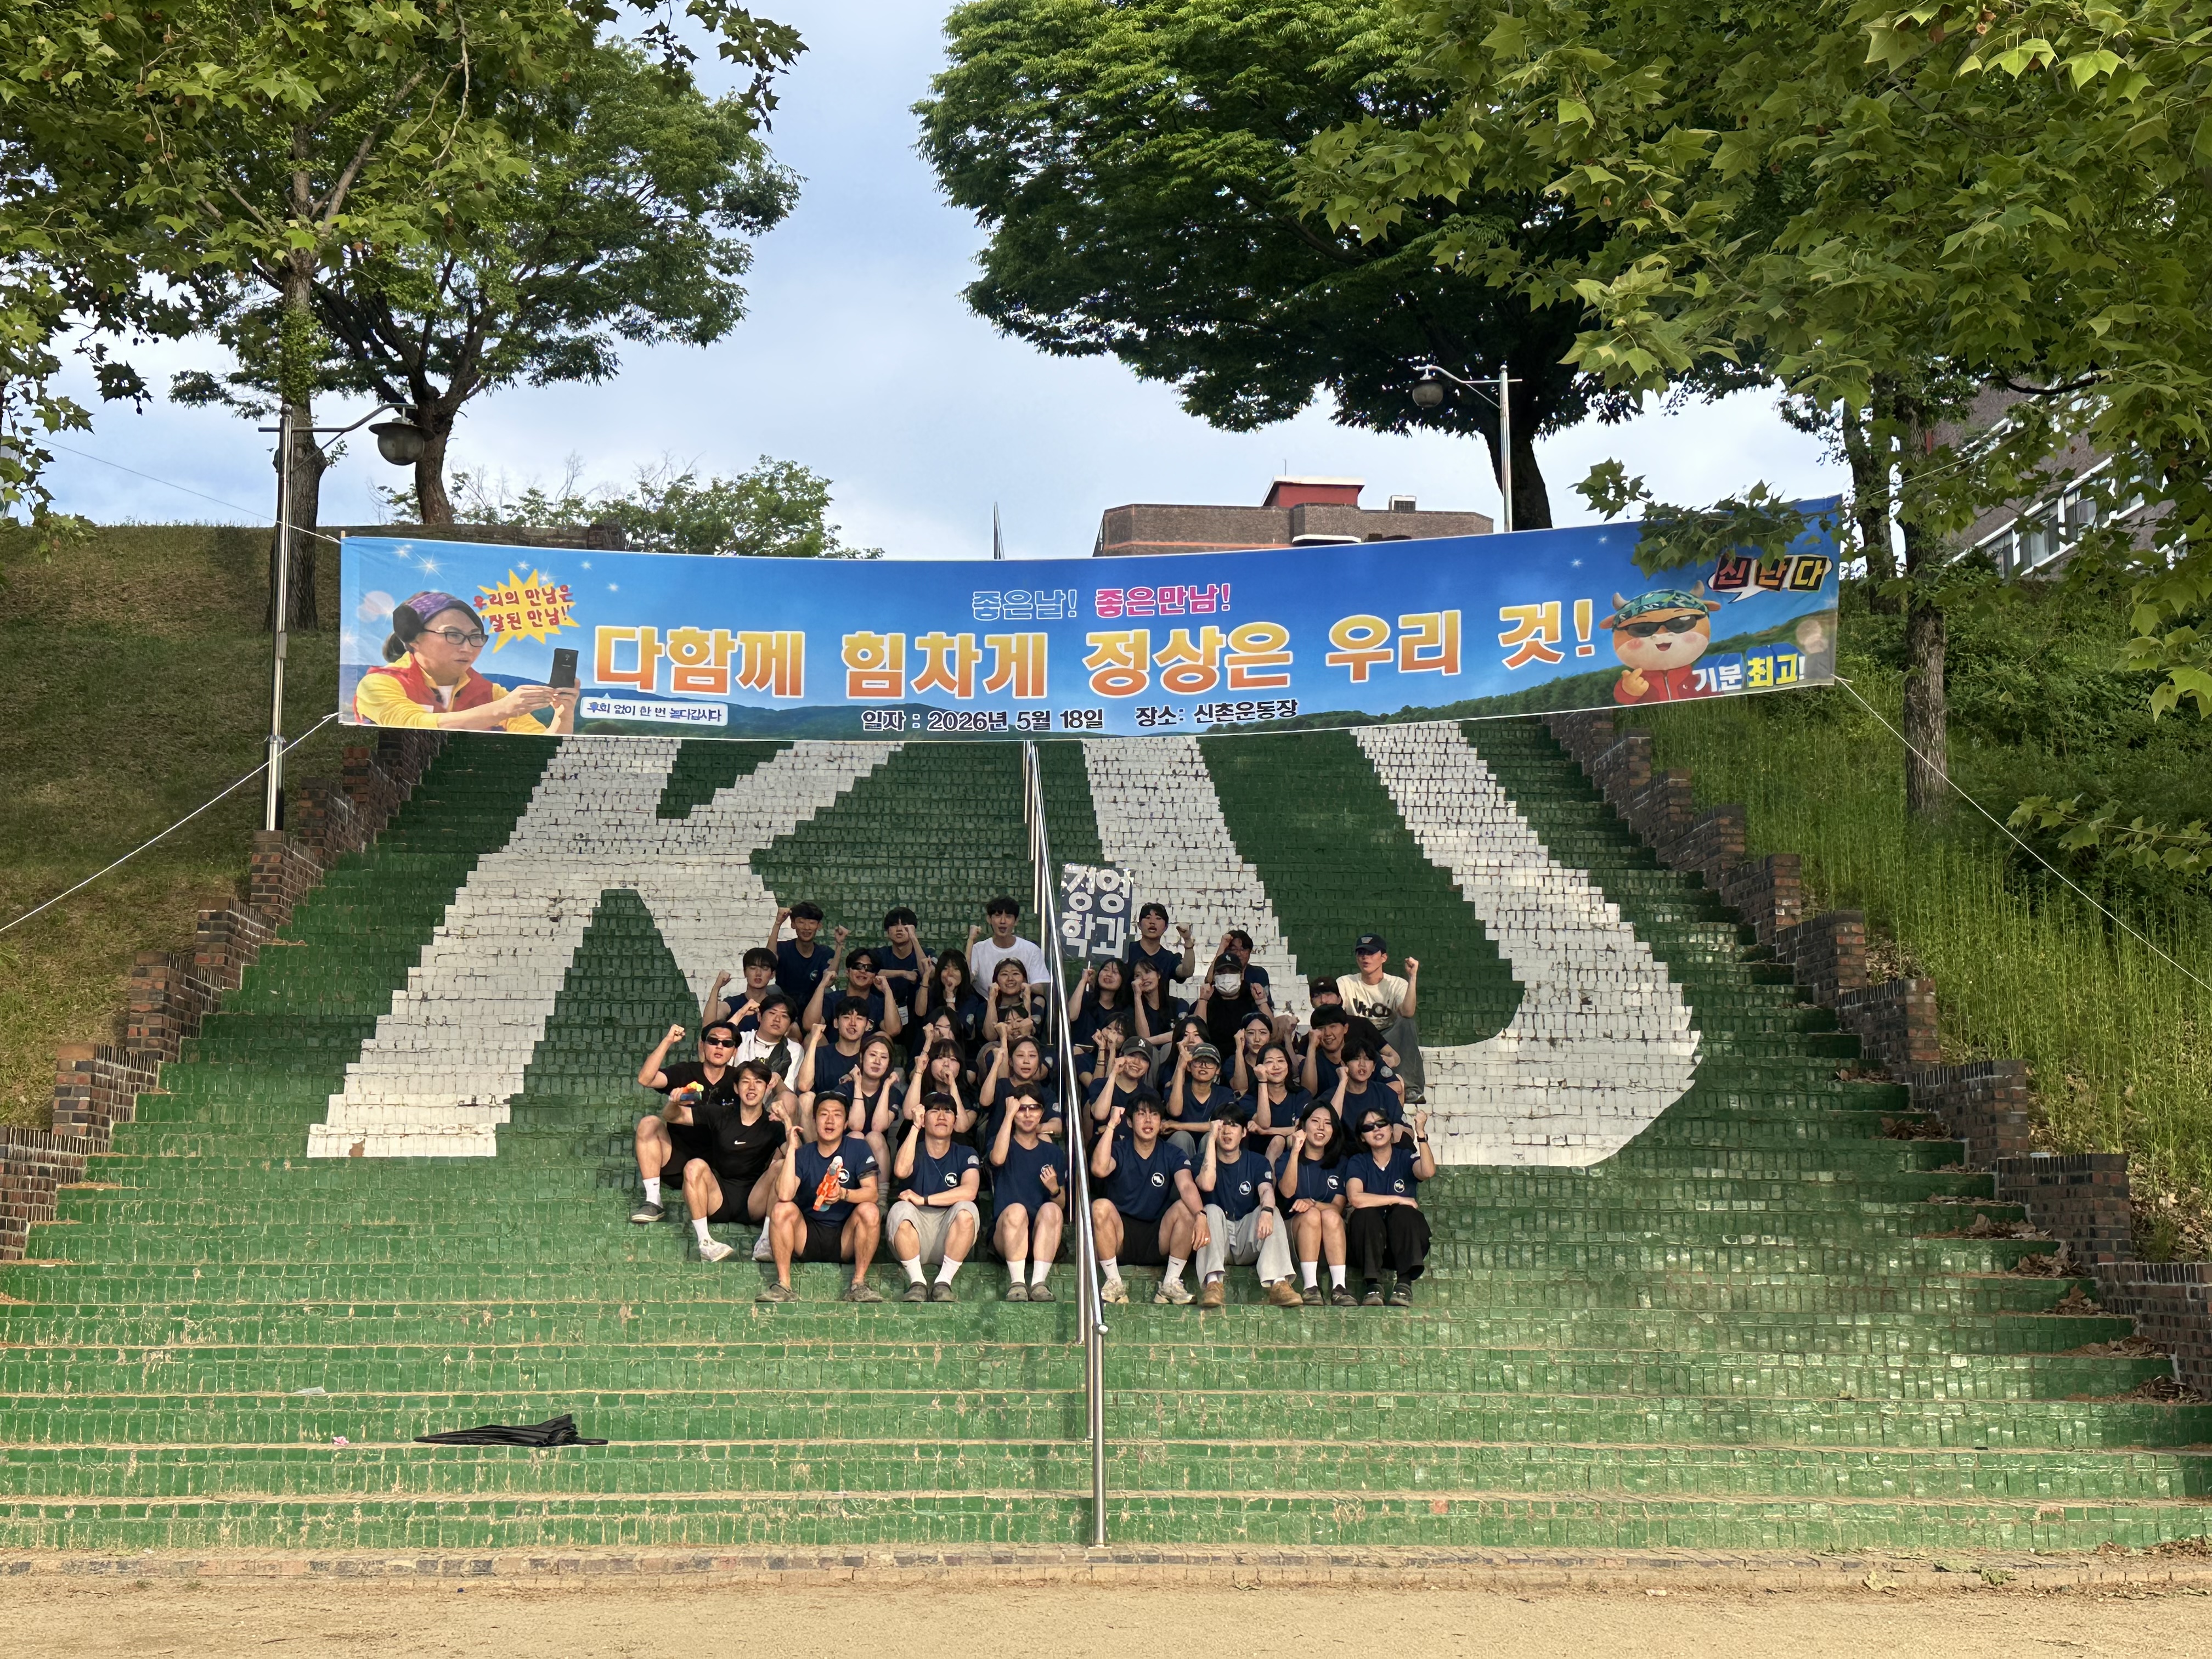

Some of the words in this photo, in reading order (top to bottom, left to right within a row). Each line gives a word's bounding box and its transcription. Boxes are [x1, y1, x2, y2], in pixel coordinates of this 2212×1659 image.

[473, 590, 520, 610] 우리의
[524, 584, 574, 607] 만남은
[972, 589, 1077, 621] 좋은날!
[1095, 583, 1231, 618] 좋은만남!
[594, 625, 805, 699] 다함께
[840, 630, 1048, 700] 힘차게
[1082, 621, 1294, 698] 정상은
[1325, 609, 1462, 684] 우리
[1498, 599, 1595, 671] 것!
[1747, 652, 1806, 688] 최고!
[614, 704, 636, 716] 없이
[639, 706, 652, 717] 한
[654, 707, 666, 718] 번
[861, 710, 906, 732] 일자
[927, 710, 1009, 732] 2026년
[1015, 710, 1052, 732] 5월
[1060, 708, 1104, 730] 18일
[1135, 706, 1185, 727] 장소:
[1193, 699, 1299, 724] 신촌운동장
[1063, 864, 1132, 913] 경영
[1062, 911, 1127, 958] 학과
